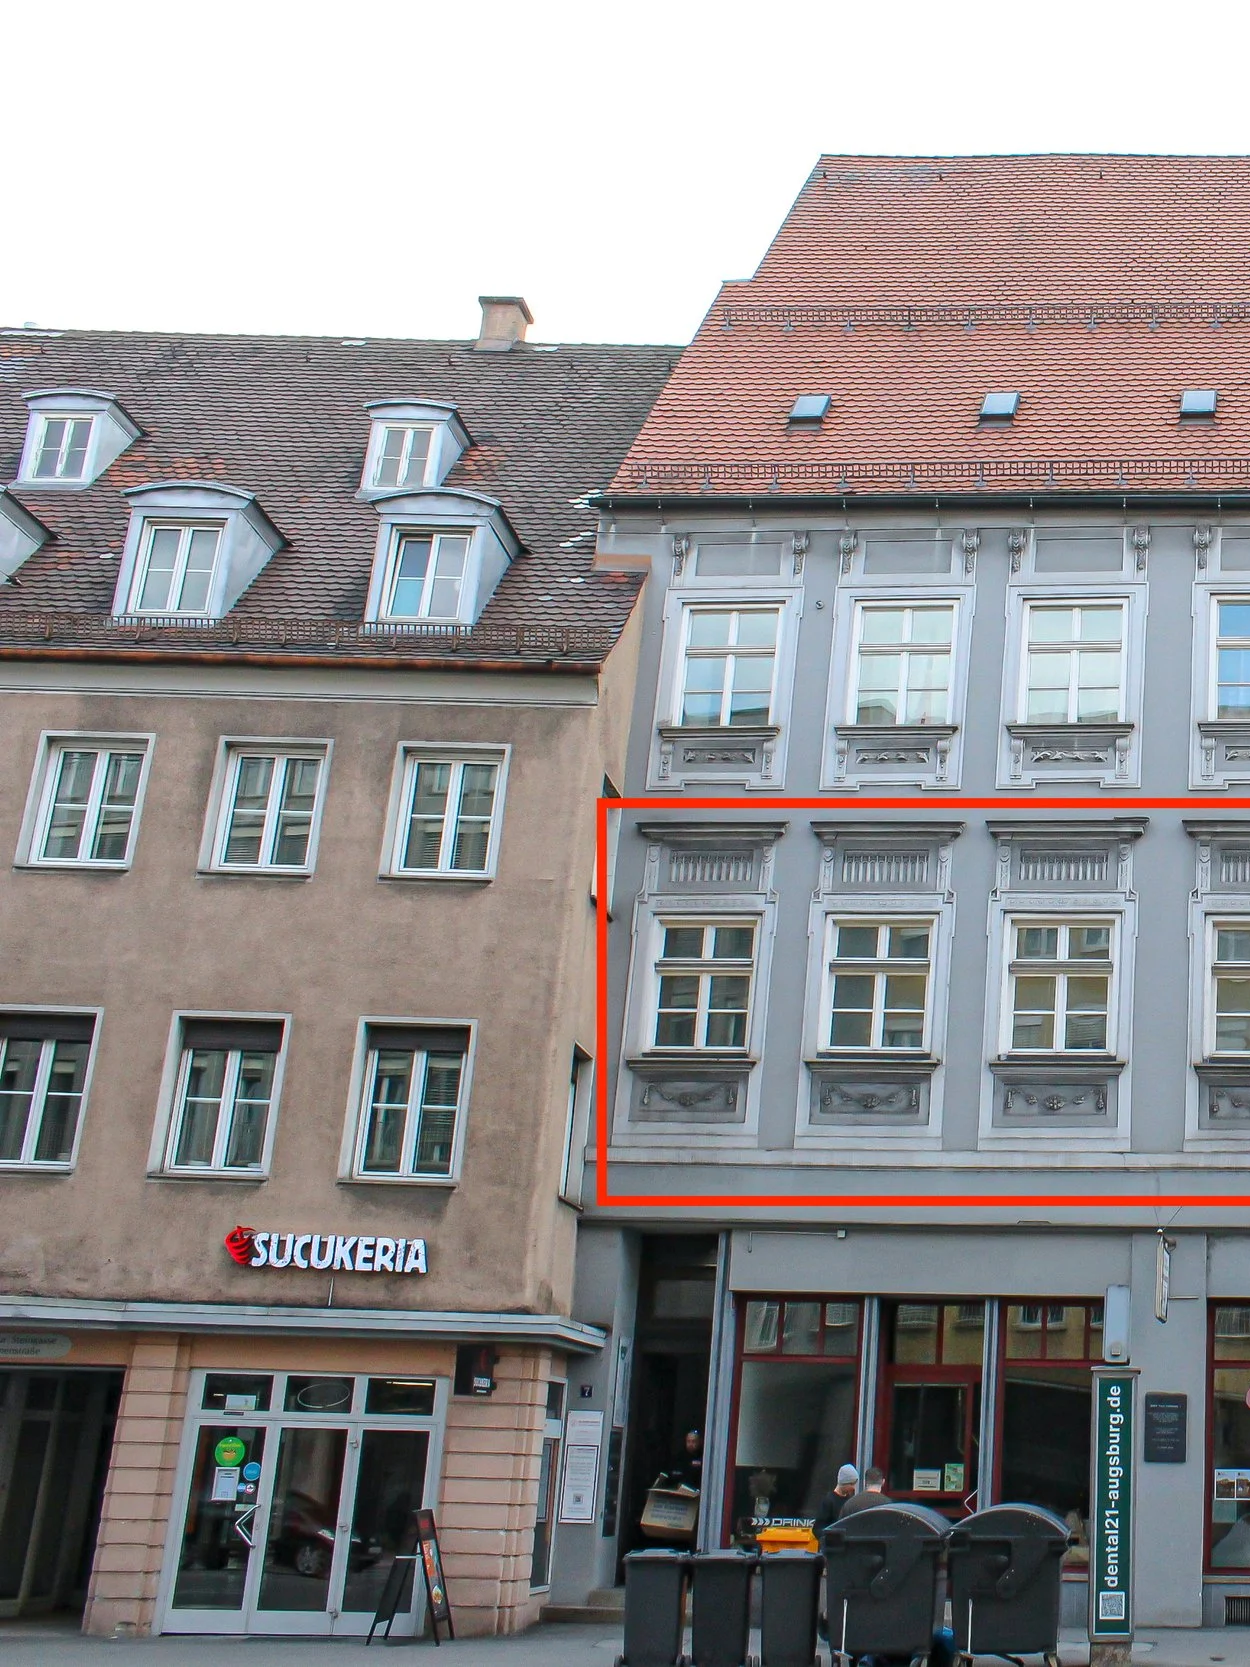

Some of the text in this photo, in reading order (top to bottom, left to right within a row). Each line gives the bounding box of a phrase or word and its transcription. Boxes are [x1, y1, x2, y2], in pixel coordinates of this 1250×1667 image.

[250, 1231, 428, 1274] SUCUKERIA
[584, 1386, 590, 1396] 7
[1104, 1385, 1124, 1588] dental21-augsburg.de
